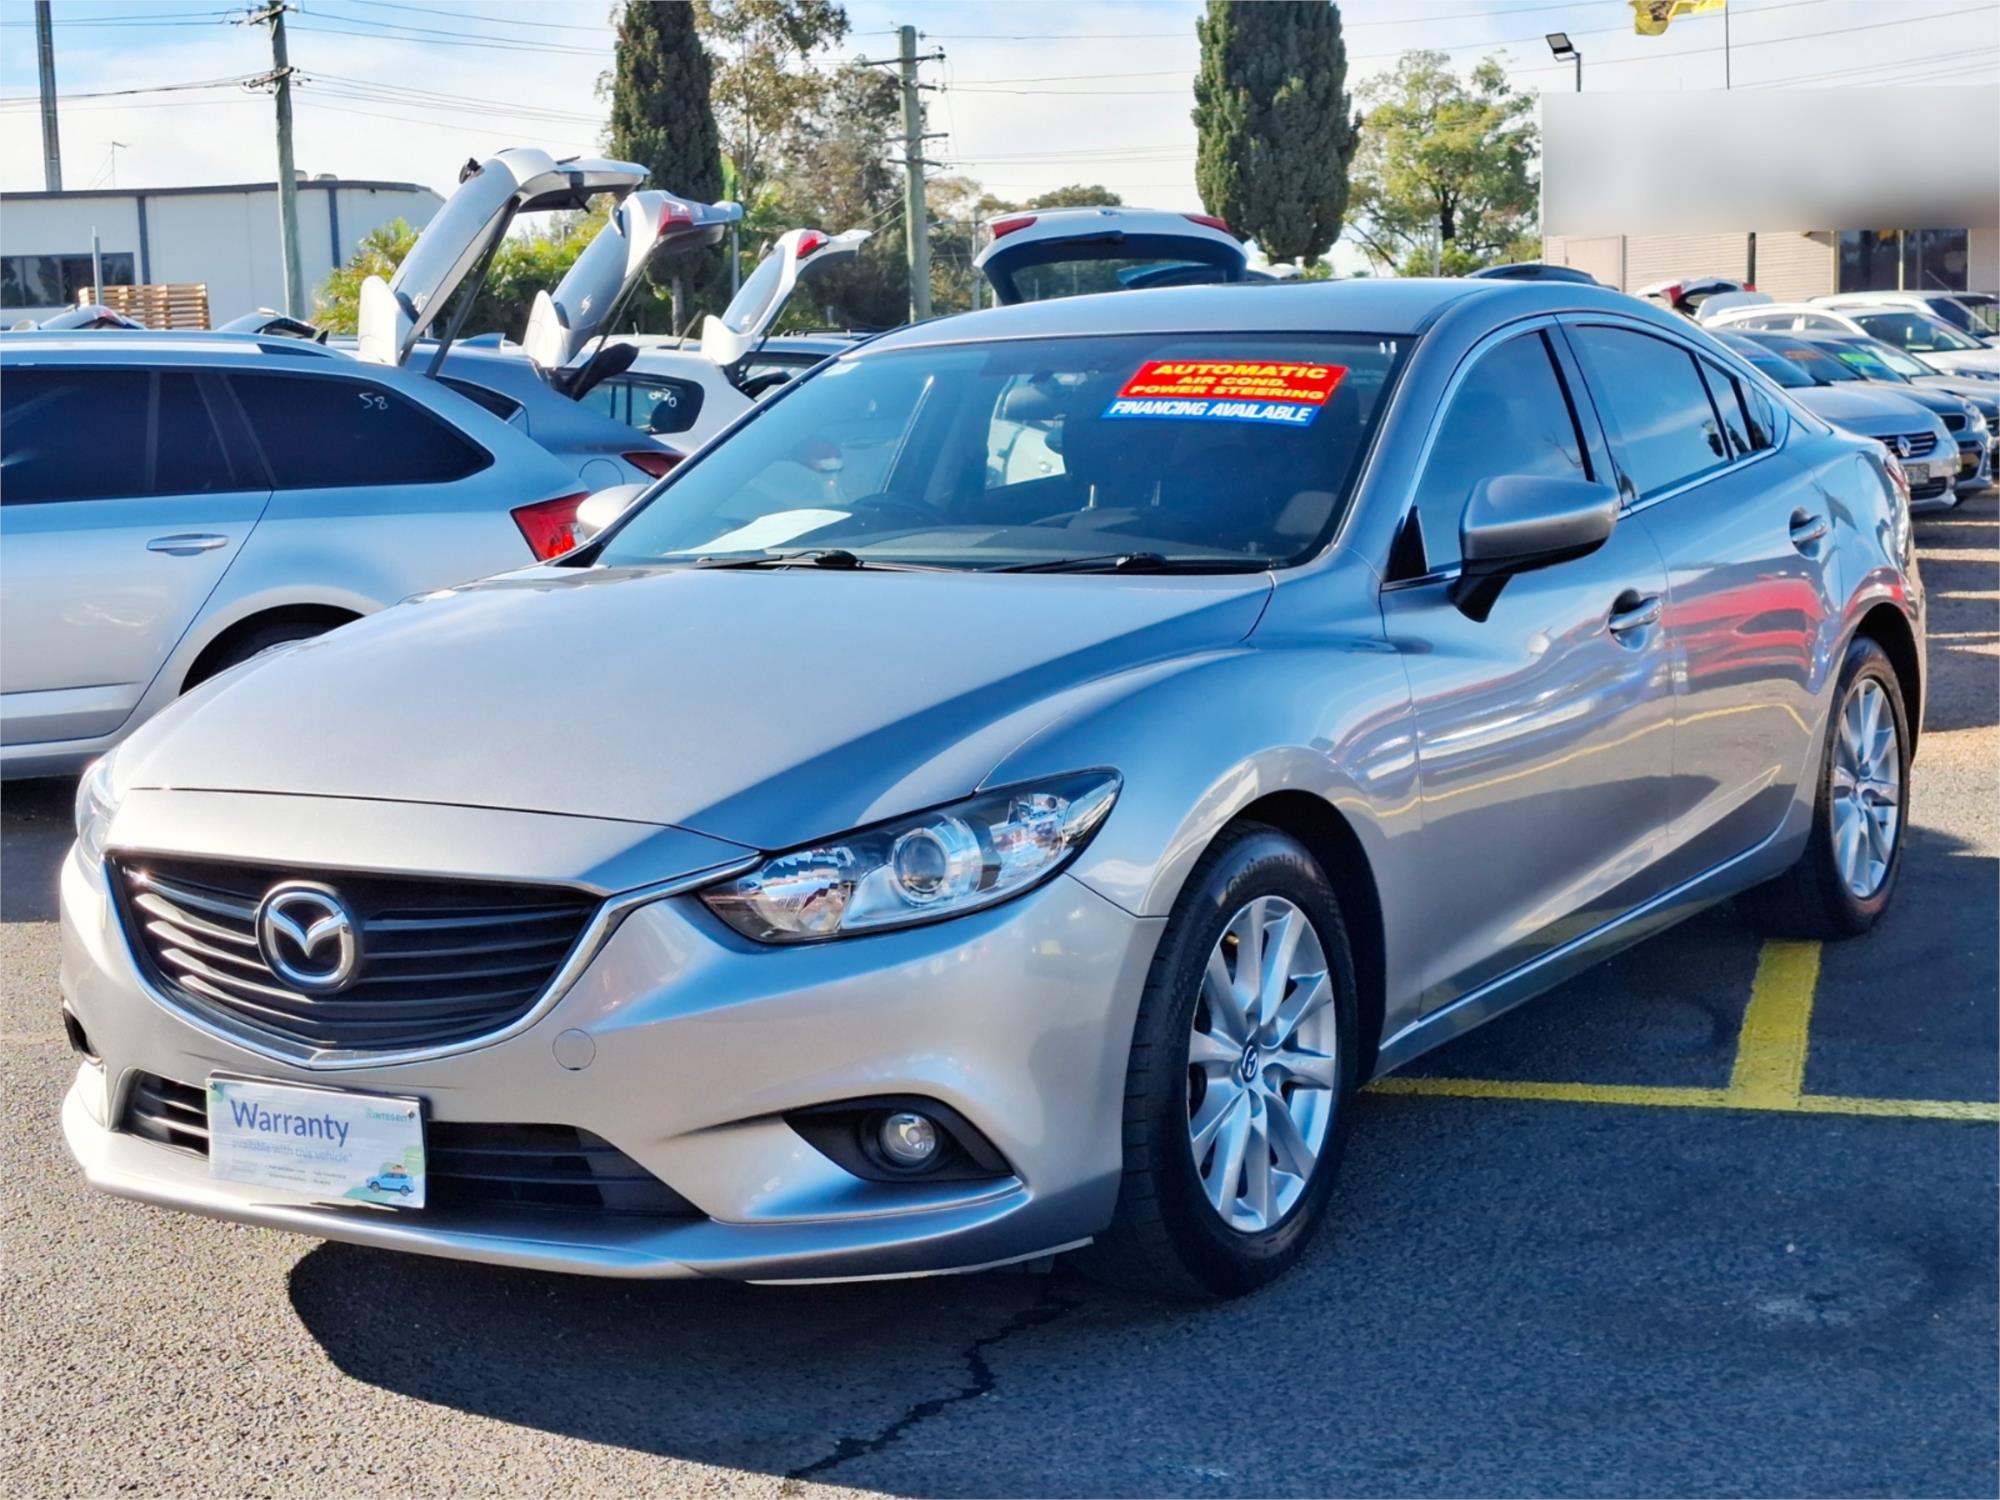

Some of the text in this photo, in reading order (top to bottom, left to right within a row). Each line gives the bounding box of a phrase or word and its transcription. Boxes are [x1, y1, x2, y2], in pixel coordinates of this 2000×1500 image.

[1152, 363, 1328, 379] AUTOMATIC
[1177, 376, 1288, 388] AIR COND.
[1129, 384, 1326, 400] POWER STEERING
[358, 392, 389, 410] 58
[1109, 401, 1313, 422] FINANCING AVAILABLE
[230, 1098, 349, 1148] Warranty
[272, 1144, 294, 1156] with
[295, 1148, 315, 1160] this
